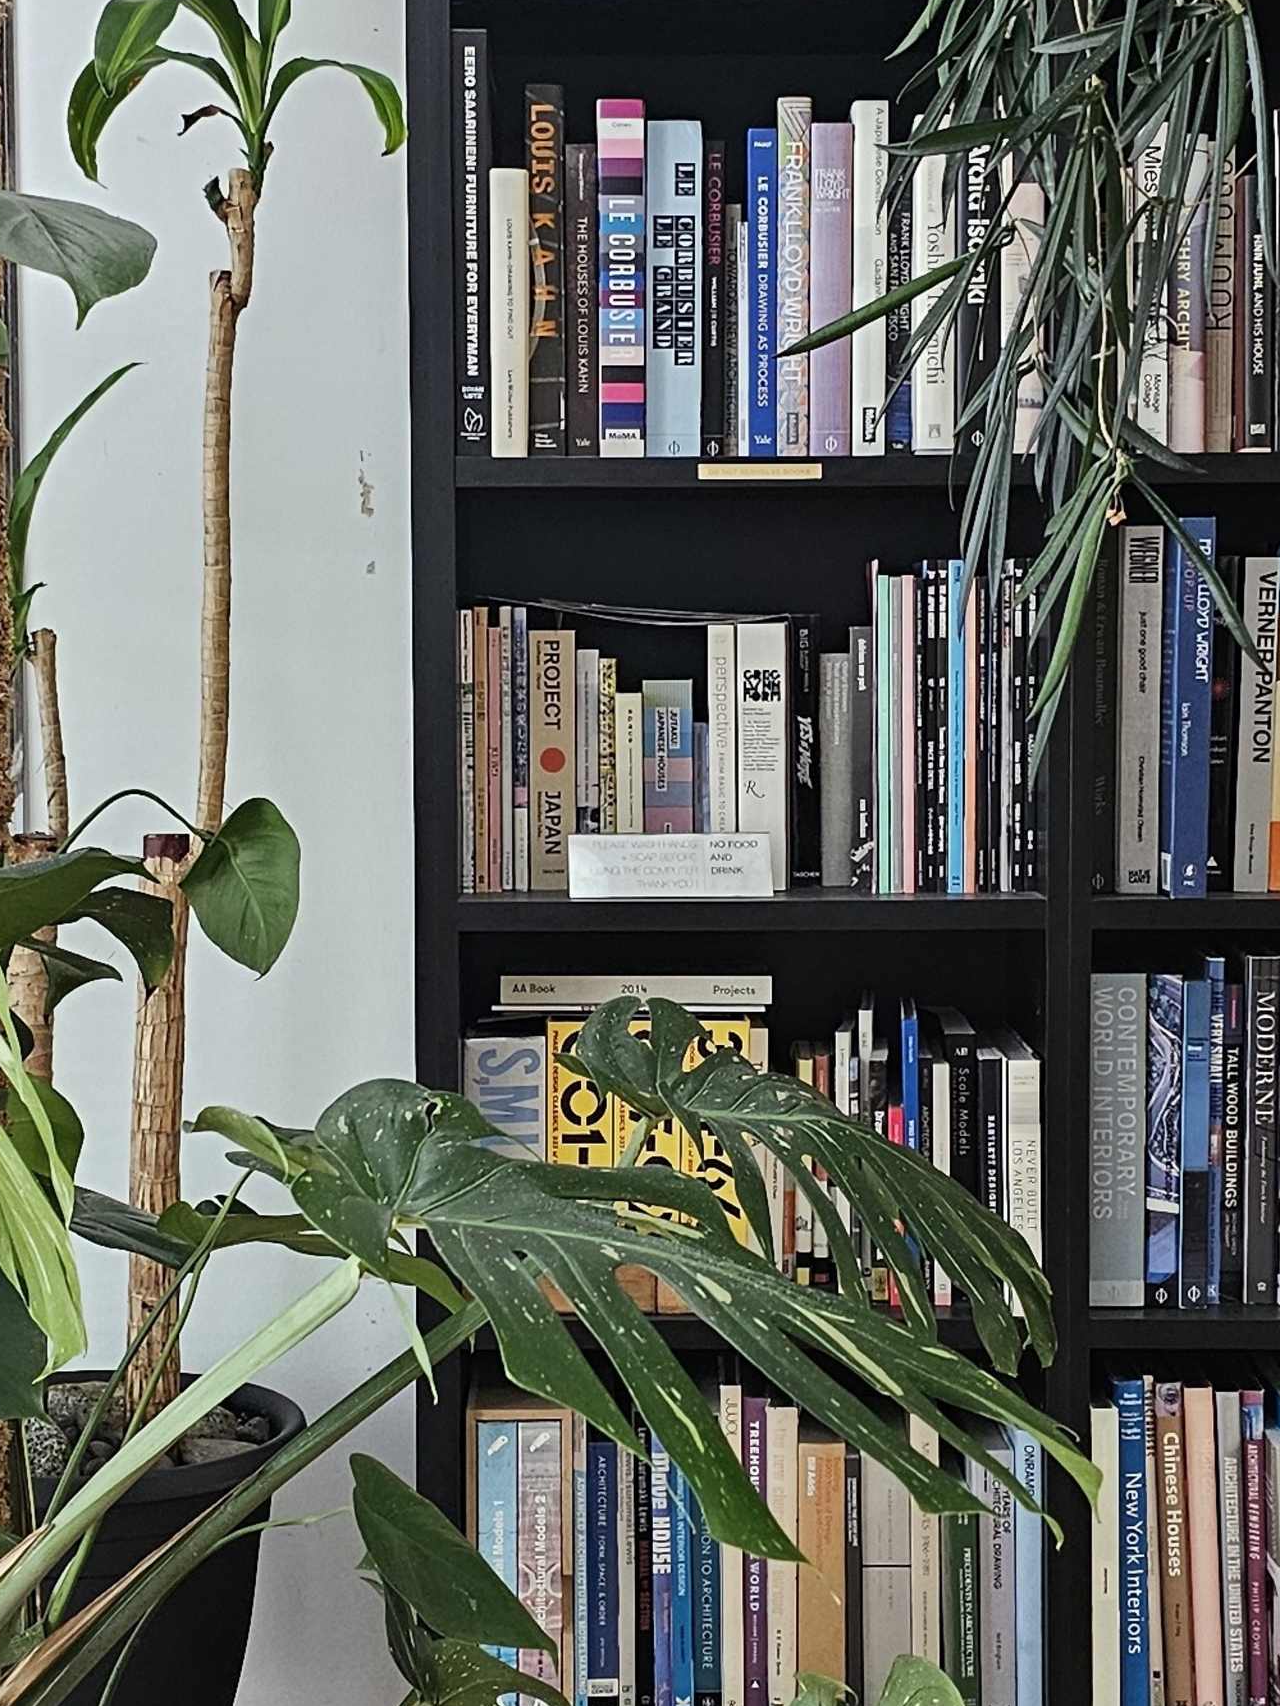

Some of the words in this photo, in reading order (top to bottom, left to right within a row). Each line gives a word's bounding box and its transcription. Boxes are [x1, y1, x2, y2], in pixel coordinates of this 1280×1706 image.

[464, 46, 476, 87] EERO
[531, 103, 554, 192] LOUIS
[676, 164, 695, 195] LE
[758, 176, 769, 191] LE
[785, 140, 803, 216] FRANK
[465, 174, 477, 260] FURNITURE
[577, 218, 588, 241] THE
[608, 198, 635, 223] LE
[654, 216, 674, 247] LE
[758, 197, 769, 268] CORBUSIER
[466, 263, 478, 293] FOR
[577, 245, 588, 294] HOUSES
[785, 219, 803, 291] LLOYD
[577, 298, 588, 314] OF
[608, 234, 635, 361] CORBUSIER
[654, 266, 674, 348] GRAND
[676, 216, 695, 365] CORBUSIER
[758, 274, 769, 331] DRAWING
[466, 296, 478, 375] EVERYMAN
[577, 318, 588, 355] LOUIS
[758, 335, 769, 350] AS
[578, 358, 588, 392] KAHN
[758, 354, 769, 407] PROCESS
[1129, 536, 1160, 584] WEGNER
[1138, 647, 1148, 670] good
[543, 640, 560, 729] PROJECT
[1138, 672, 1148, 694] chair
[1253, 671, 1273, 743] PANTON
[656, 709, 666, 754] JAPANESE
[656, 755, 666, 790] HOUSES
[544, 791, 562, 854] JAPAN
[710, 854, 733, 862] AND
[711, 866, 744, 875] DRINK
[529, 984, 555, 994] Book
[620, 984, 647, 993] 2014
[713, 984, 756, 995] Projects
[1092, 987, 1112, 1083] WORLD
[1255, 991, 1276, 1125] MODERNE
[959, 1068, 970, 1102] Scale
[1226, 1048, 1239, 1079] TALL
[1117, 987, 1137, 1198] CONTEMPORARY
[1225, 1082, 1238, 1124] WOOD
[958, 1109, 970, 1155] Models
[1013, 1140, 1024, 1165] LOS
[1092, 1088, 1112, 1220] INTERIORS
[1026, 1140, 1037, 1184] NEVER
[1224, 1129, 1238, 1208] BUILDINGS
[1026, 1189, 1037, 1230] BUILT
[597, 1456, 607, 1526] ARCHITECTURE
[1162, 1432, 1179, 1506] Chinese
[1125, 1473, 1142, 1517] New
[1224, 1457, 1239, 1543] ARCHITECTURE
[1126, 1521, 1142, 1562] York
[1166, 1510, 1181, 1578] Houses
[701, 1558, 712, 1574] TO
[749, 1562, 760, 1611] WORLD
[964, 1548, 974, 1597] PRECEDENTS
[992, 1543, 1003, 1590] DRAWING
[701, 1581, 713, 1669] ARCHITECTURE
[1126, 1569, 1143, 1654] Interiors
[964, 1613, 974, 1677] ARCHITECTURE
